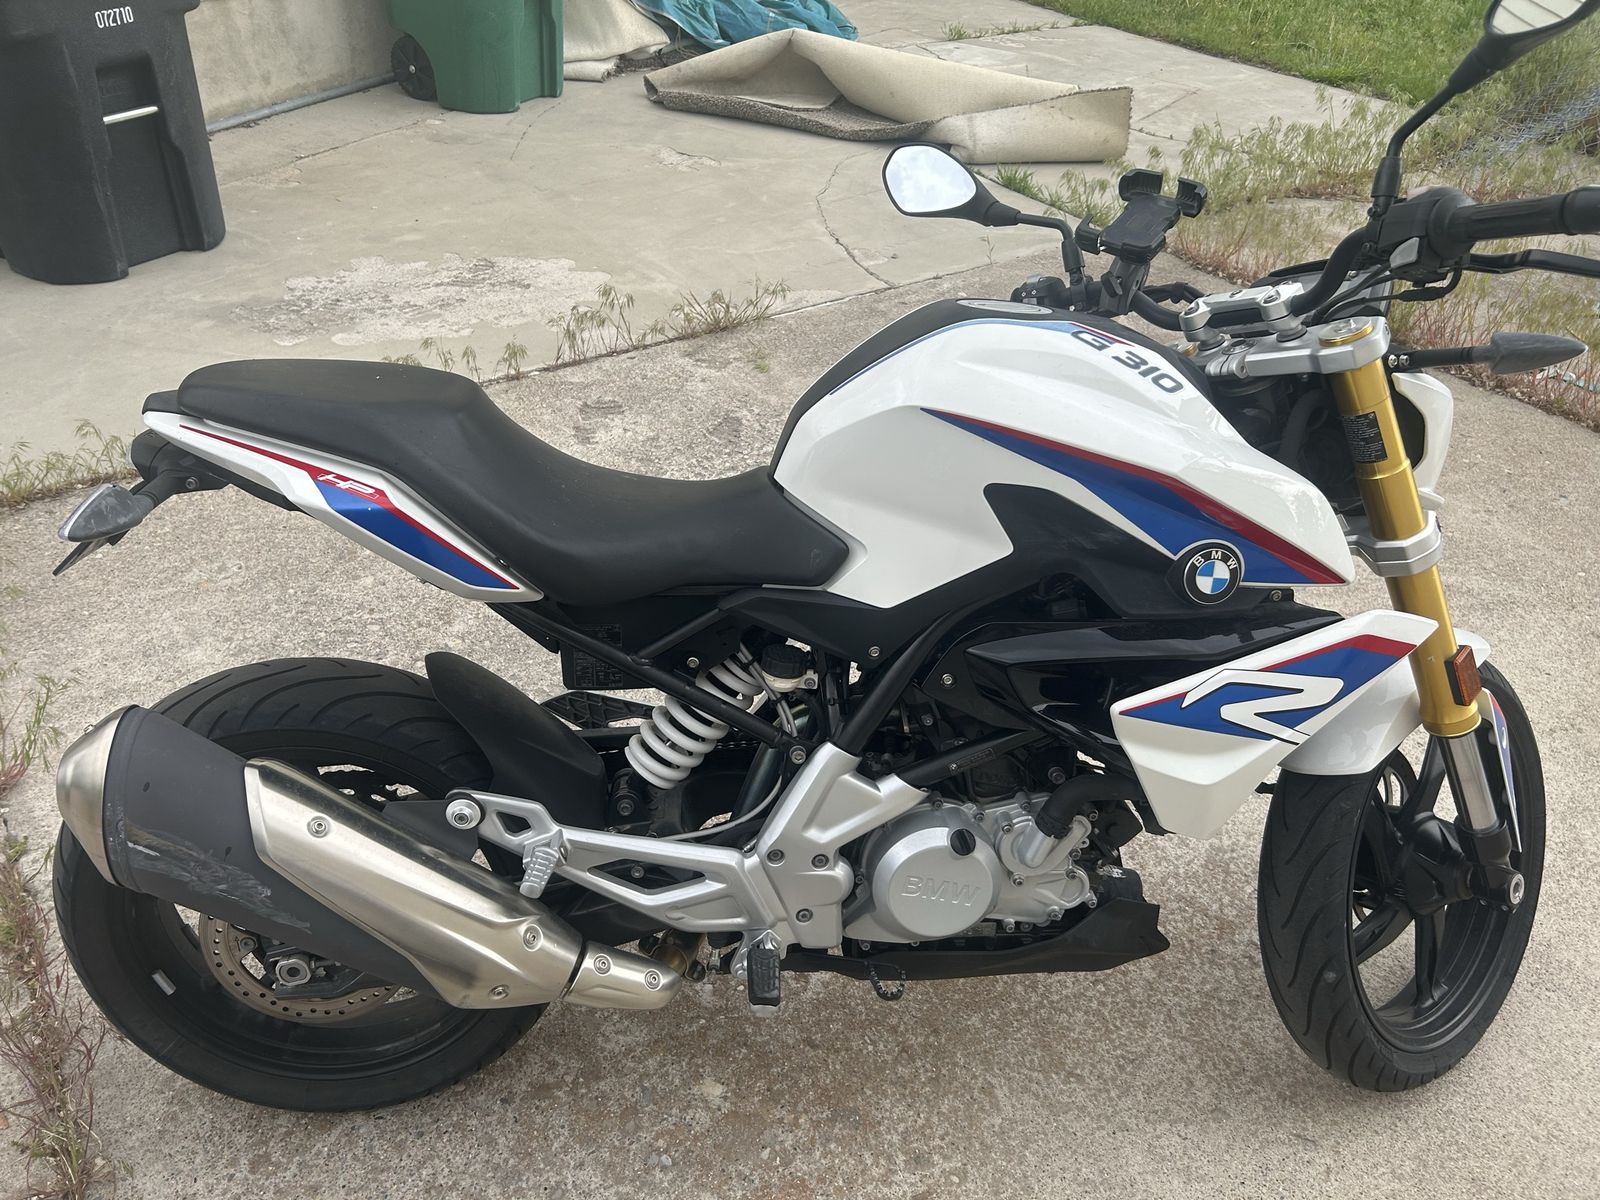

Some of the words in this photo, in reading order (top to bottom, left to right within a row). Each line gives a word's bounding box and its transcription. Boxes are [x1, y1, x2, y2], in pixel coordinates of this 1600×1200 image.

[95, 6, 134, 28] 072710
[1071, 330, 1116, 351] G
[1111, 350, 1184, 393] 310
[1193, 550, 1238, 570] BMW
[901, 875, 980, 907] BMW
